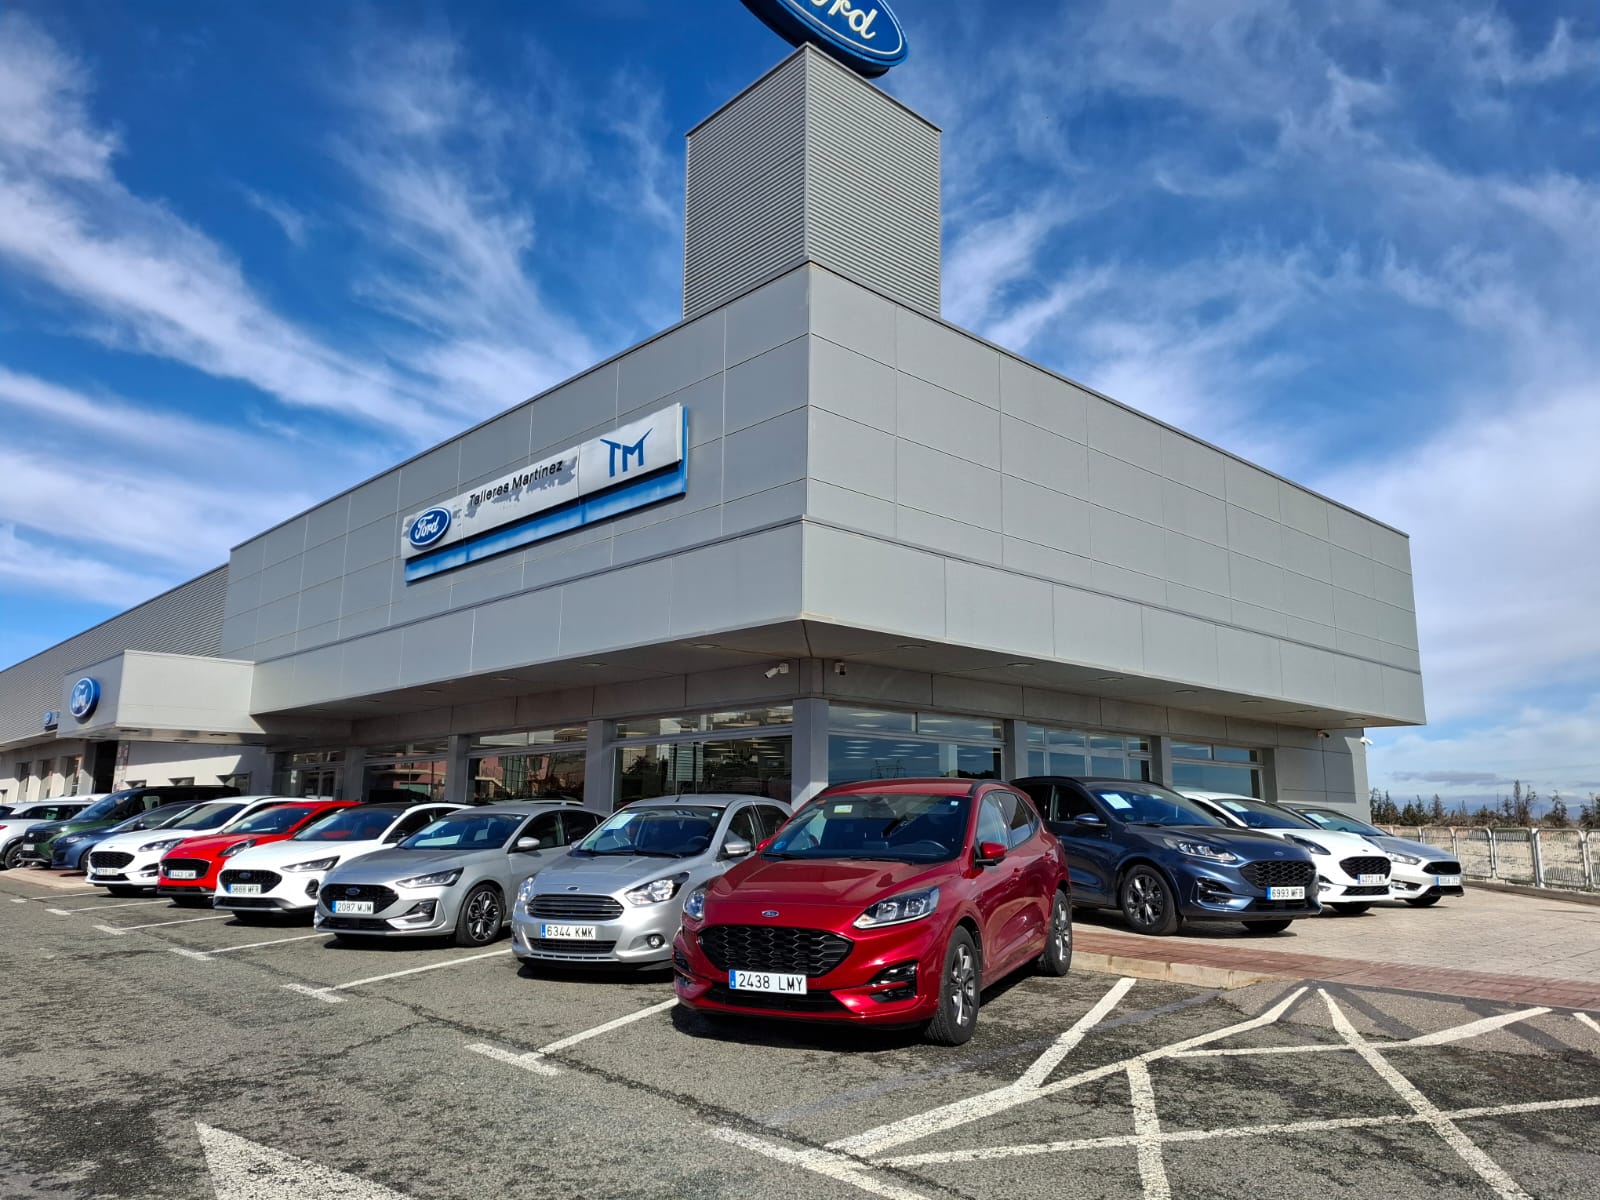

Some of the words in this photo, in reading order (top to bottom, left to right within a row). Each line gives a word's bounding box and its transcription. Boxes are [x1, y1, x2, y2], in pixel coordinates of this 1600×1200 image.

[599, 428, 654, 478] TM
[469, 483, 510, 506] Talleres
[414, 514, 440, 540] Ford
[1272, 888, 1289, 898] 6993
[337, 903, 355, 912] 2087
[547, 926, 571, 937] 6344
[575, 927, 594, 938] KMK
[739, 973, 770, 989] 2438
[778, 975, 803, 992] LMY
